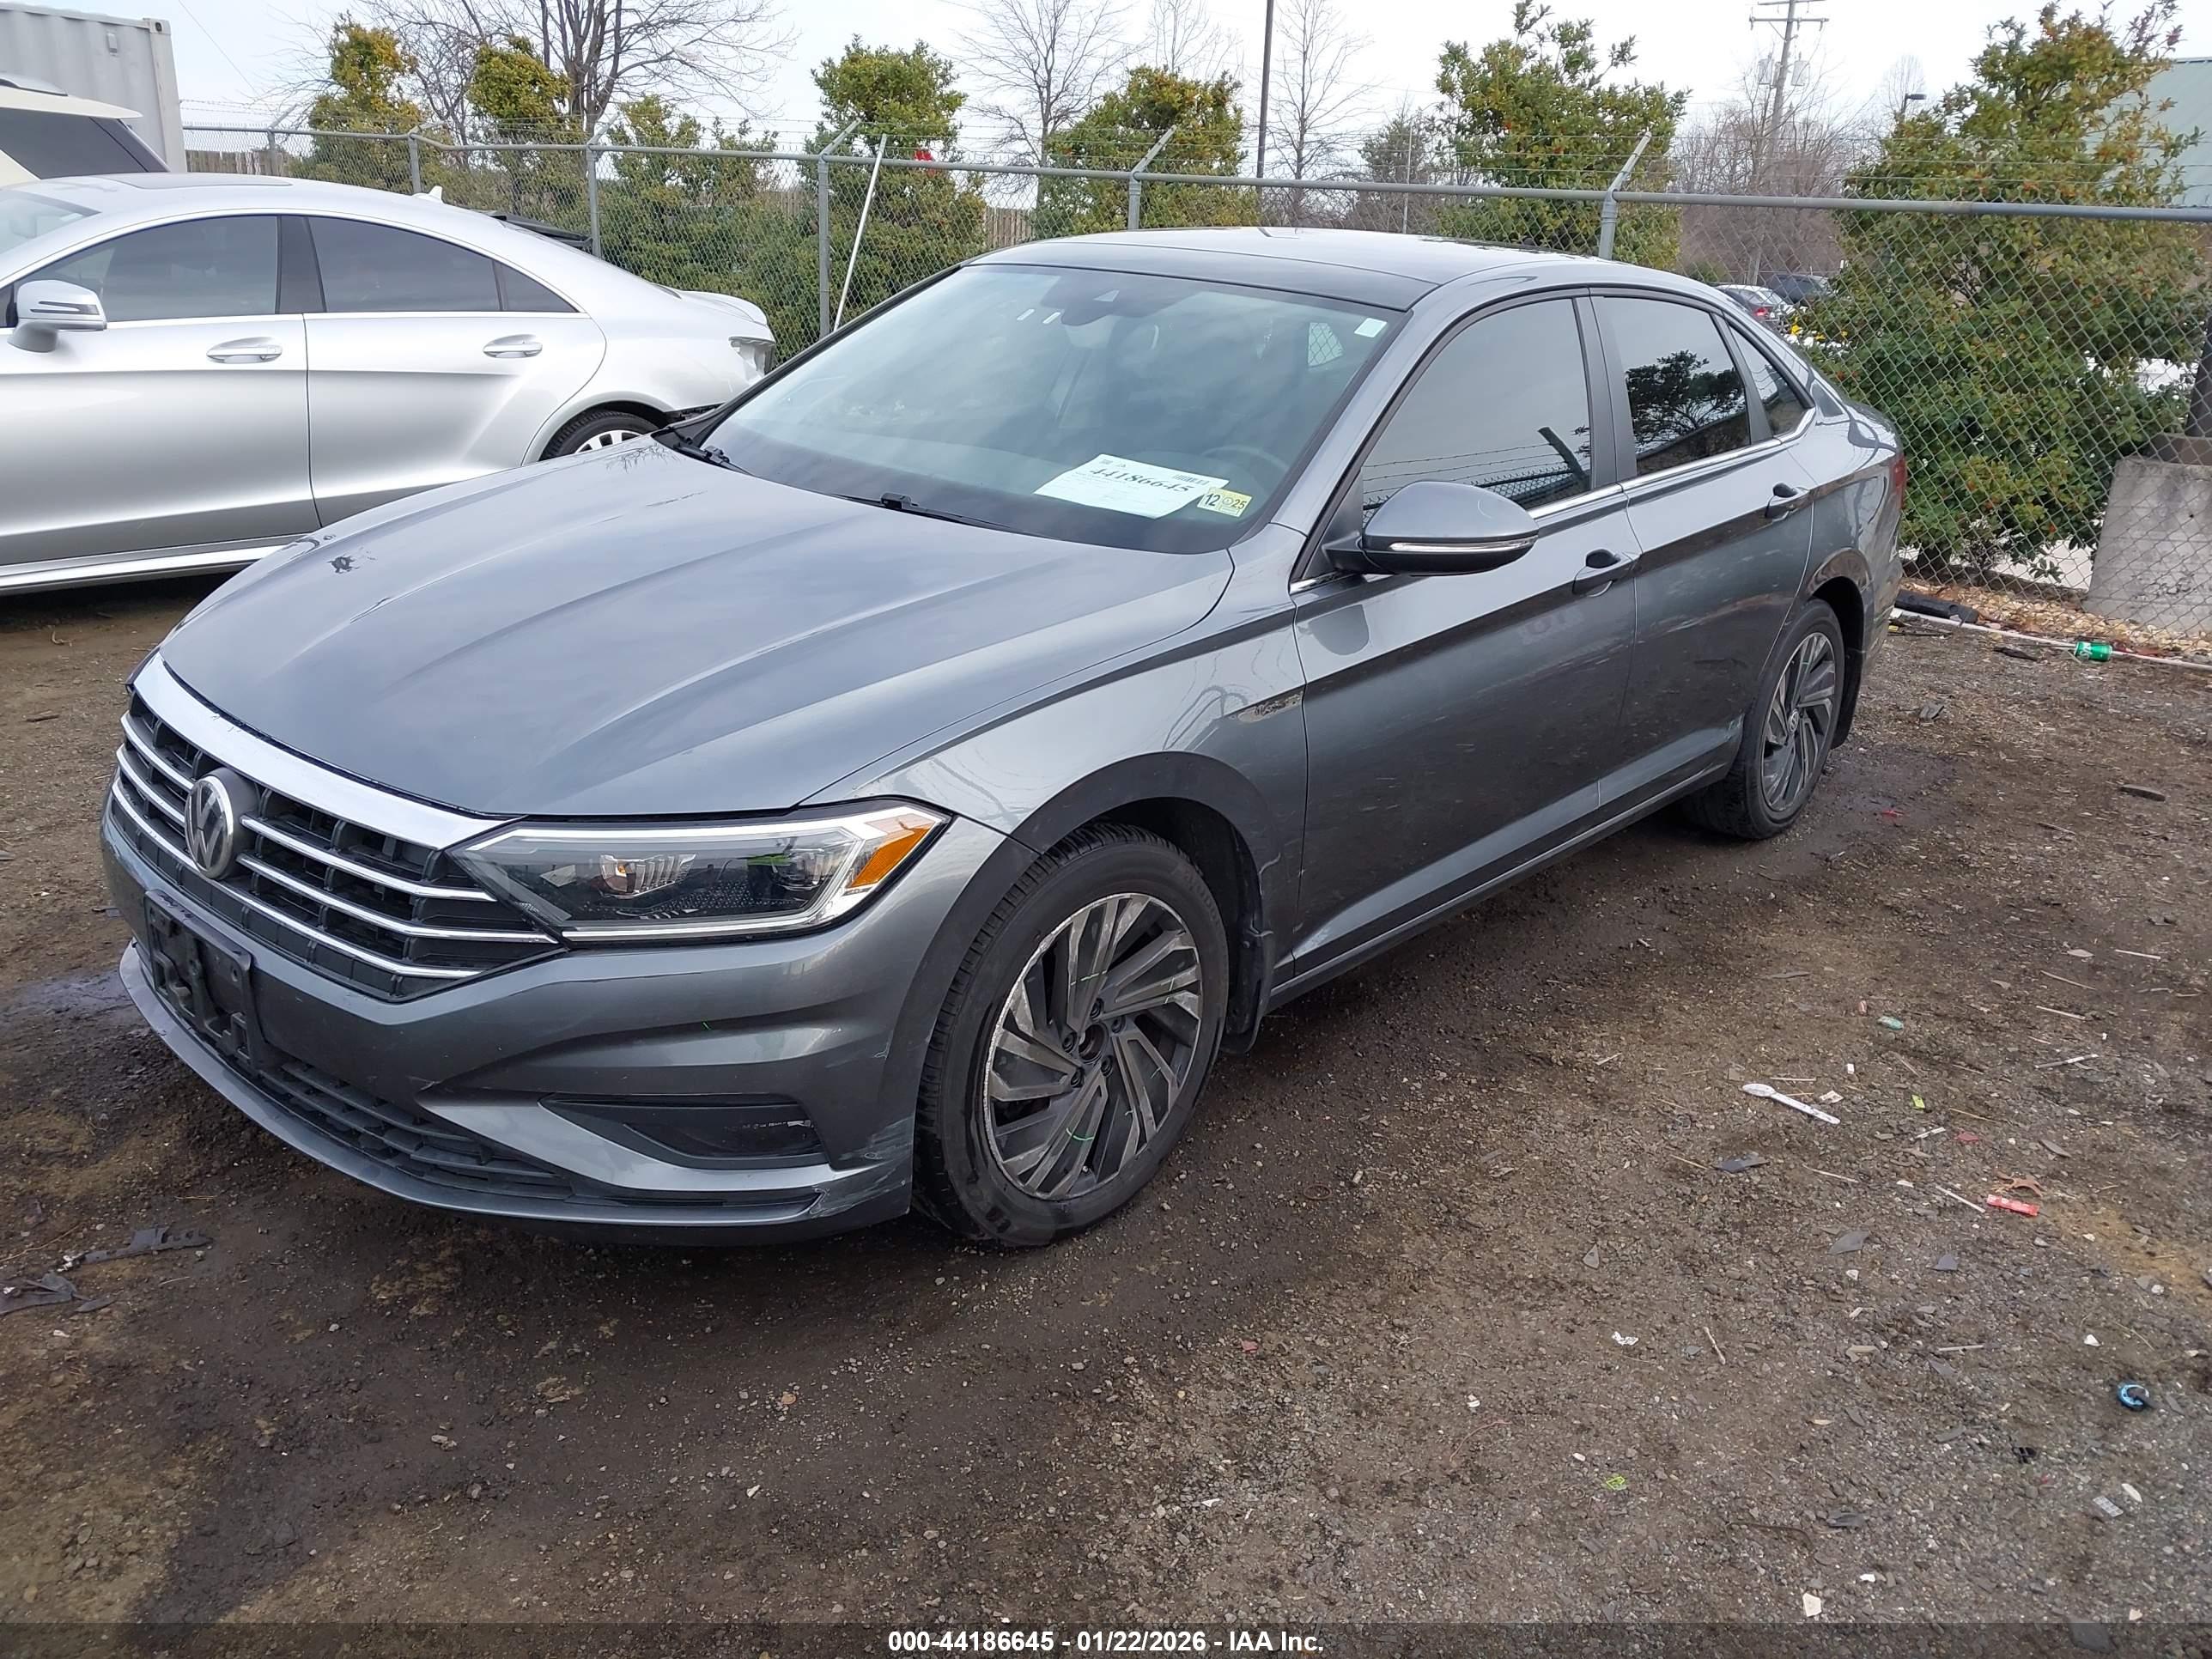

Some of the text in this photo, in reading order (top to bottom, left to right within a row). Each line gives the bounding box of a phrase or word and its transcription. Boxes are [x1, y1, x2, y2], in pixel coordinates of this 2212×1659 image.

[1089, 468, 1195, 493] 44186645
[1205, 493, 1248, 510] 12 25
